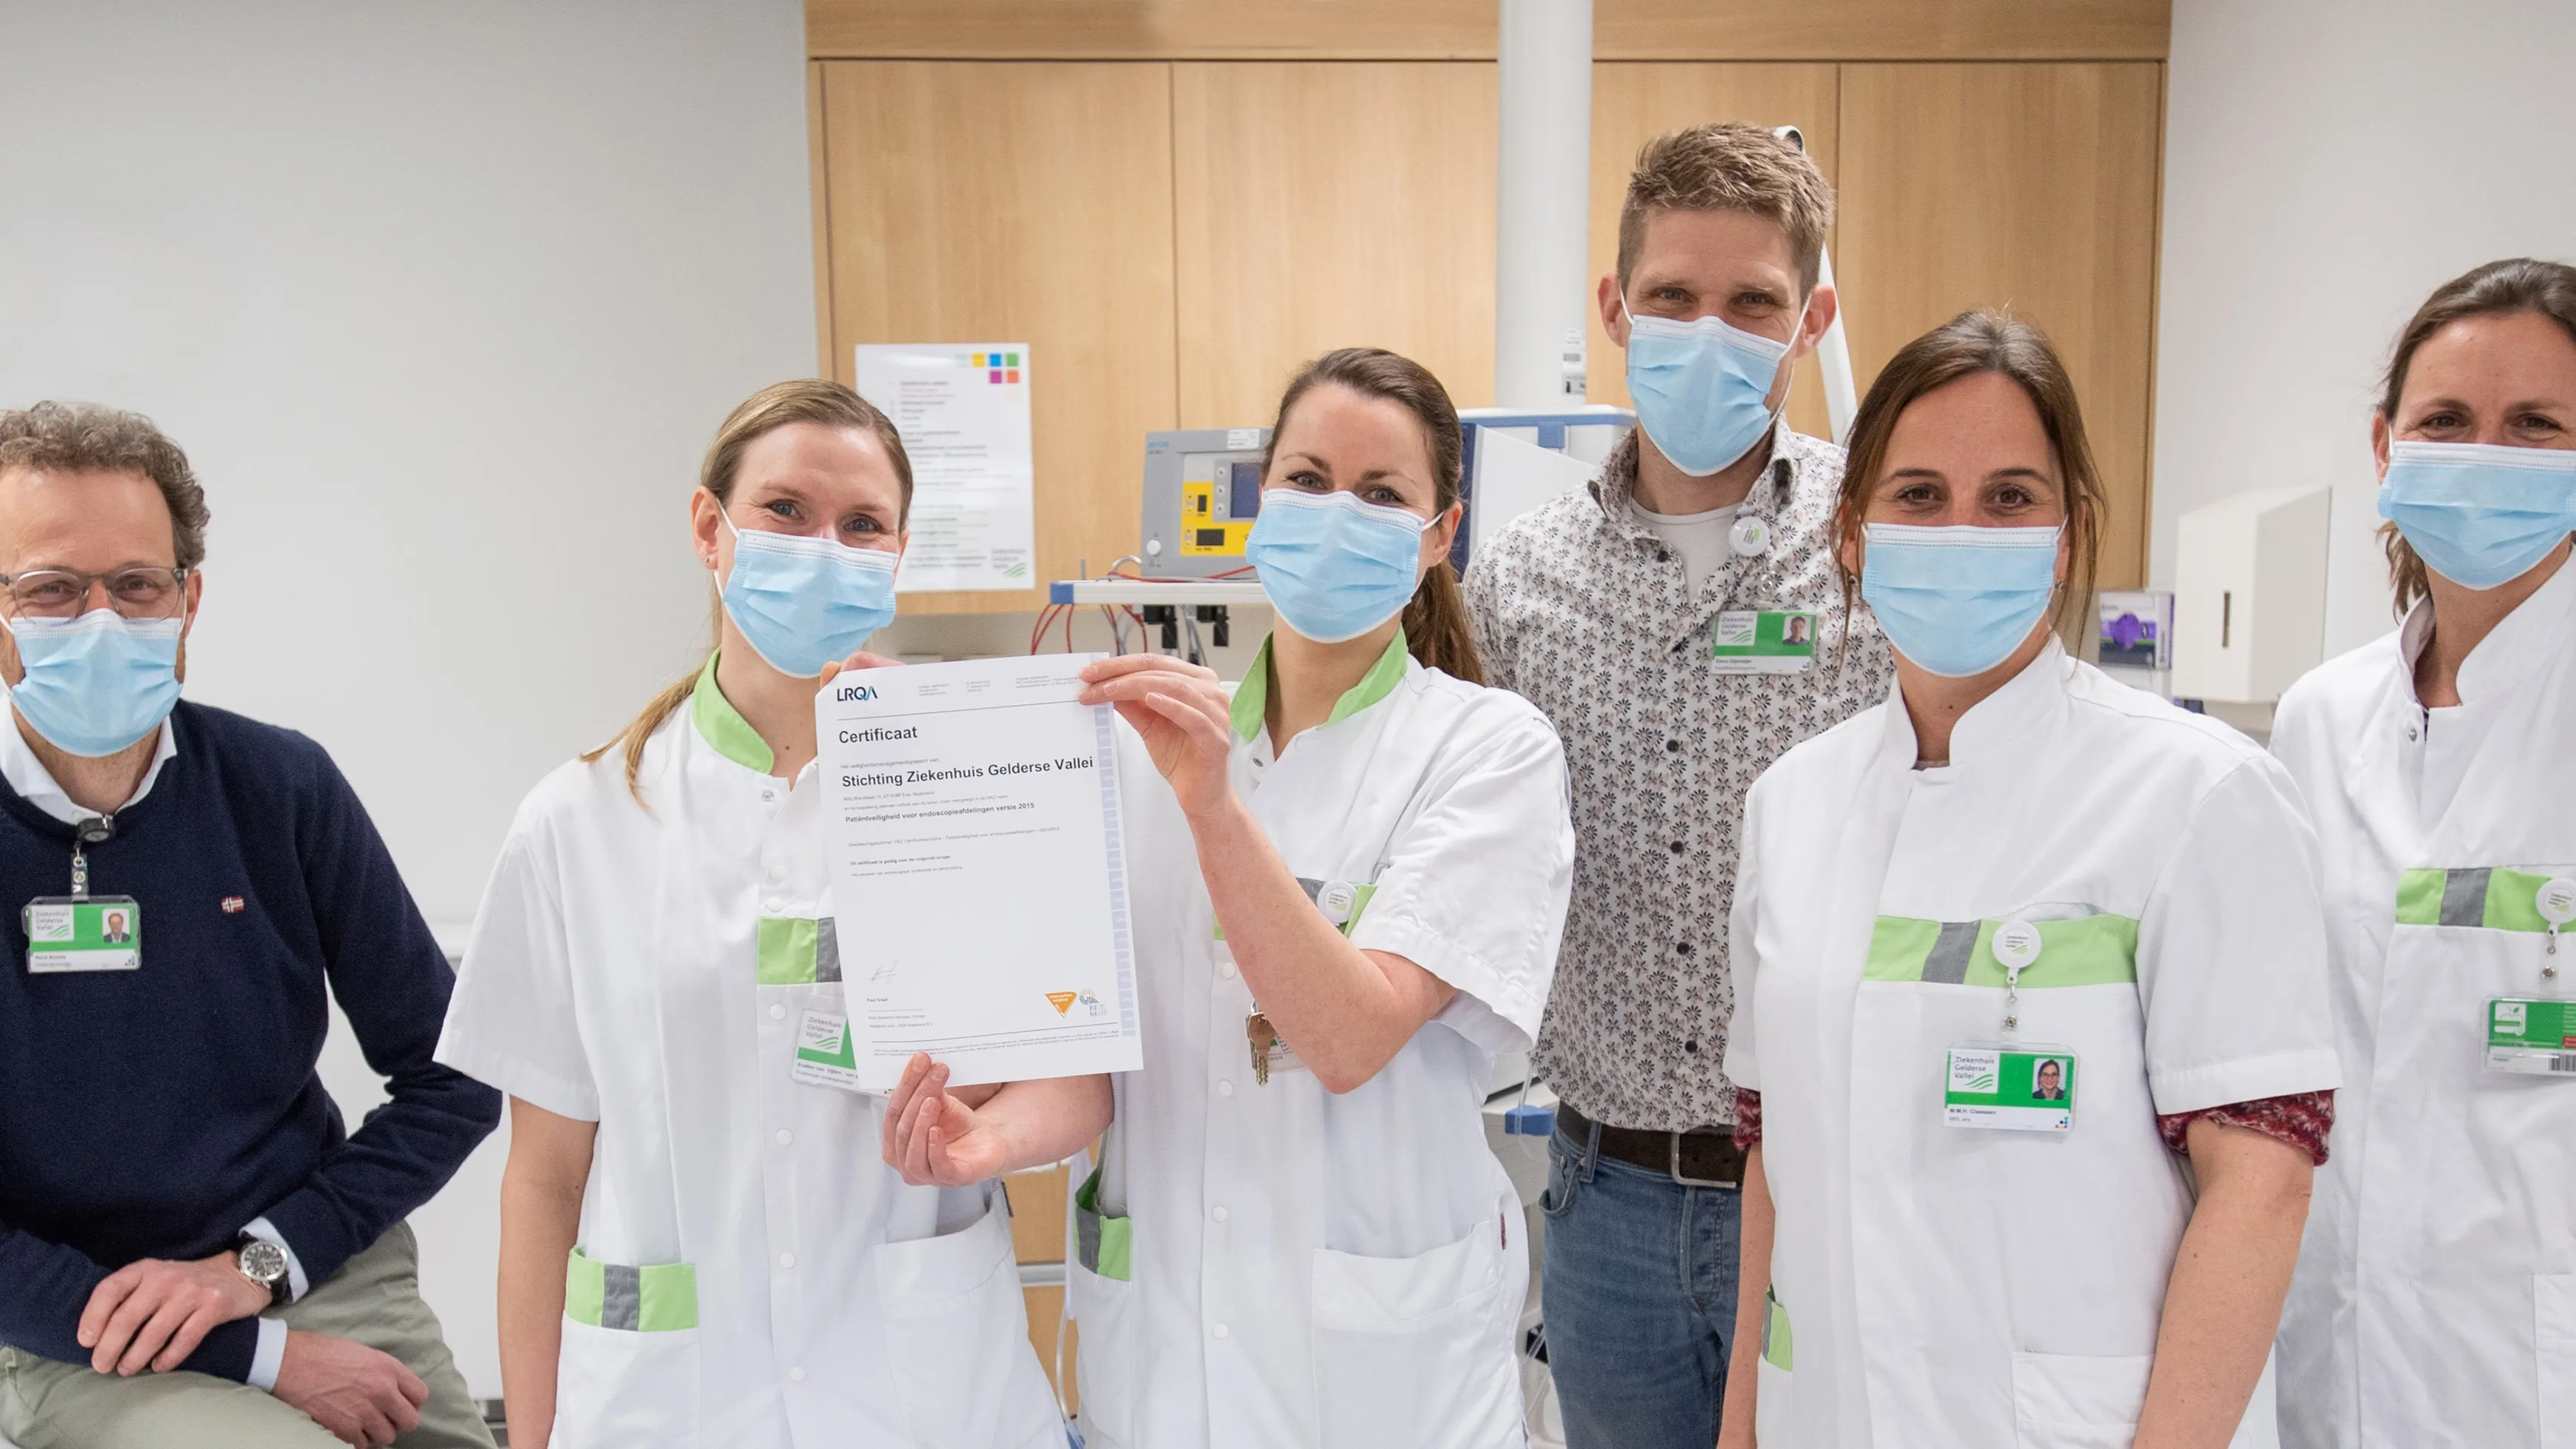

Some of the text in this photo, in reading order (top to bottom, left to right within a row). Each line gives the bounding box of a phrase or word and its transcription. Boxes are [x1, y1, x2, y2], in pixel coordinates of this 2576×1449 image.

[837, 686, 879, 702] LRQA
[839, 726, 917, 744] Certificaat
[842, 757, 1094, 787] Stichting Ziekenhuis Gelderse Vallei
[902, 811, 918, 820] voor
[919, 806, 995, 818] endoscopieafdelingen
[996, 804, 1017, 812] versie
[1018, 802, 1034, 810] 2015
[806, 1023, 834, 1034] Gelderse
[808, 1017, 841, 1028] Ziekenhuis
[806, 1031, 823, 1039] Vallei
[1955, 1057, 1995, 1065] Ziekenhuis
